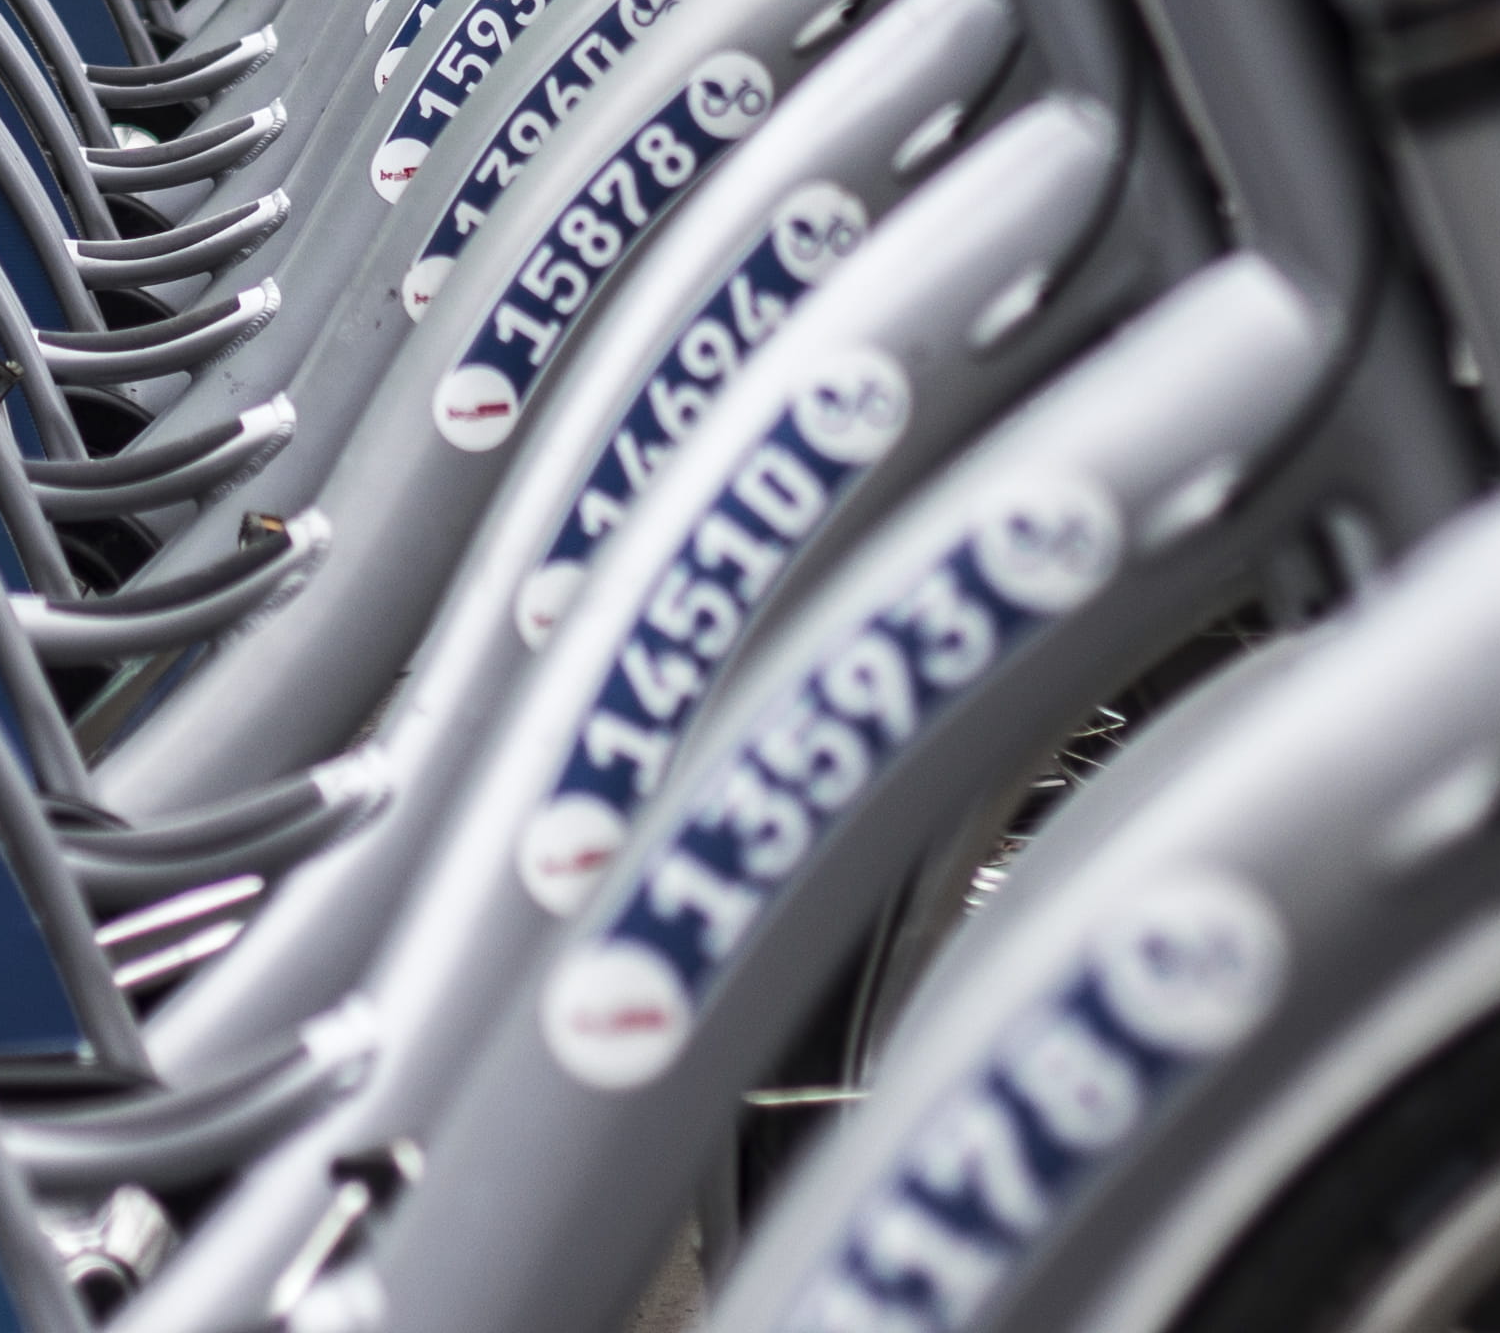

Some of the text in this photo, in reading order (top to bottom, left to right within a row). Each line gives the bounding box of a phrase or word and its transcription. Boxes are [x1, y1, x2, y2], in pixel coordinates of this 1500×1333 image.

[454, 31, 620, 237] 13960
[495, 123, 697, 367] 15878
[587, 451, 827, 801] 14510
[650, 579, 1002, 958] 13593
